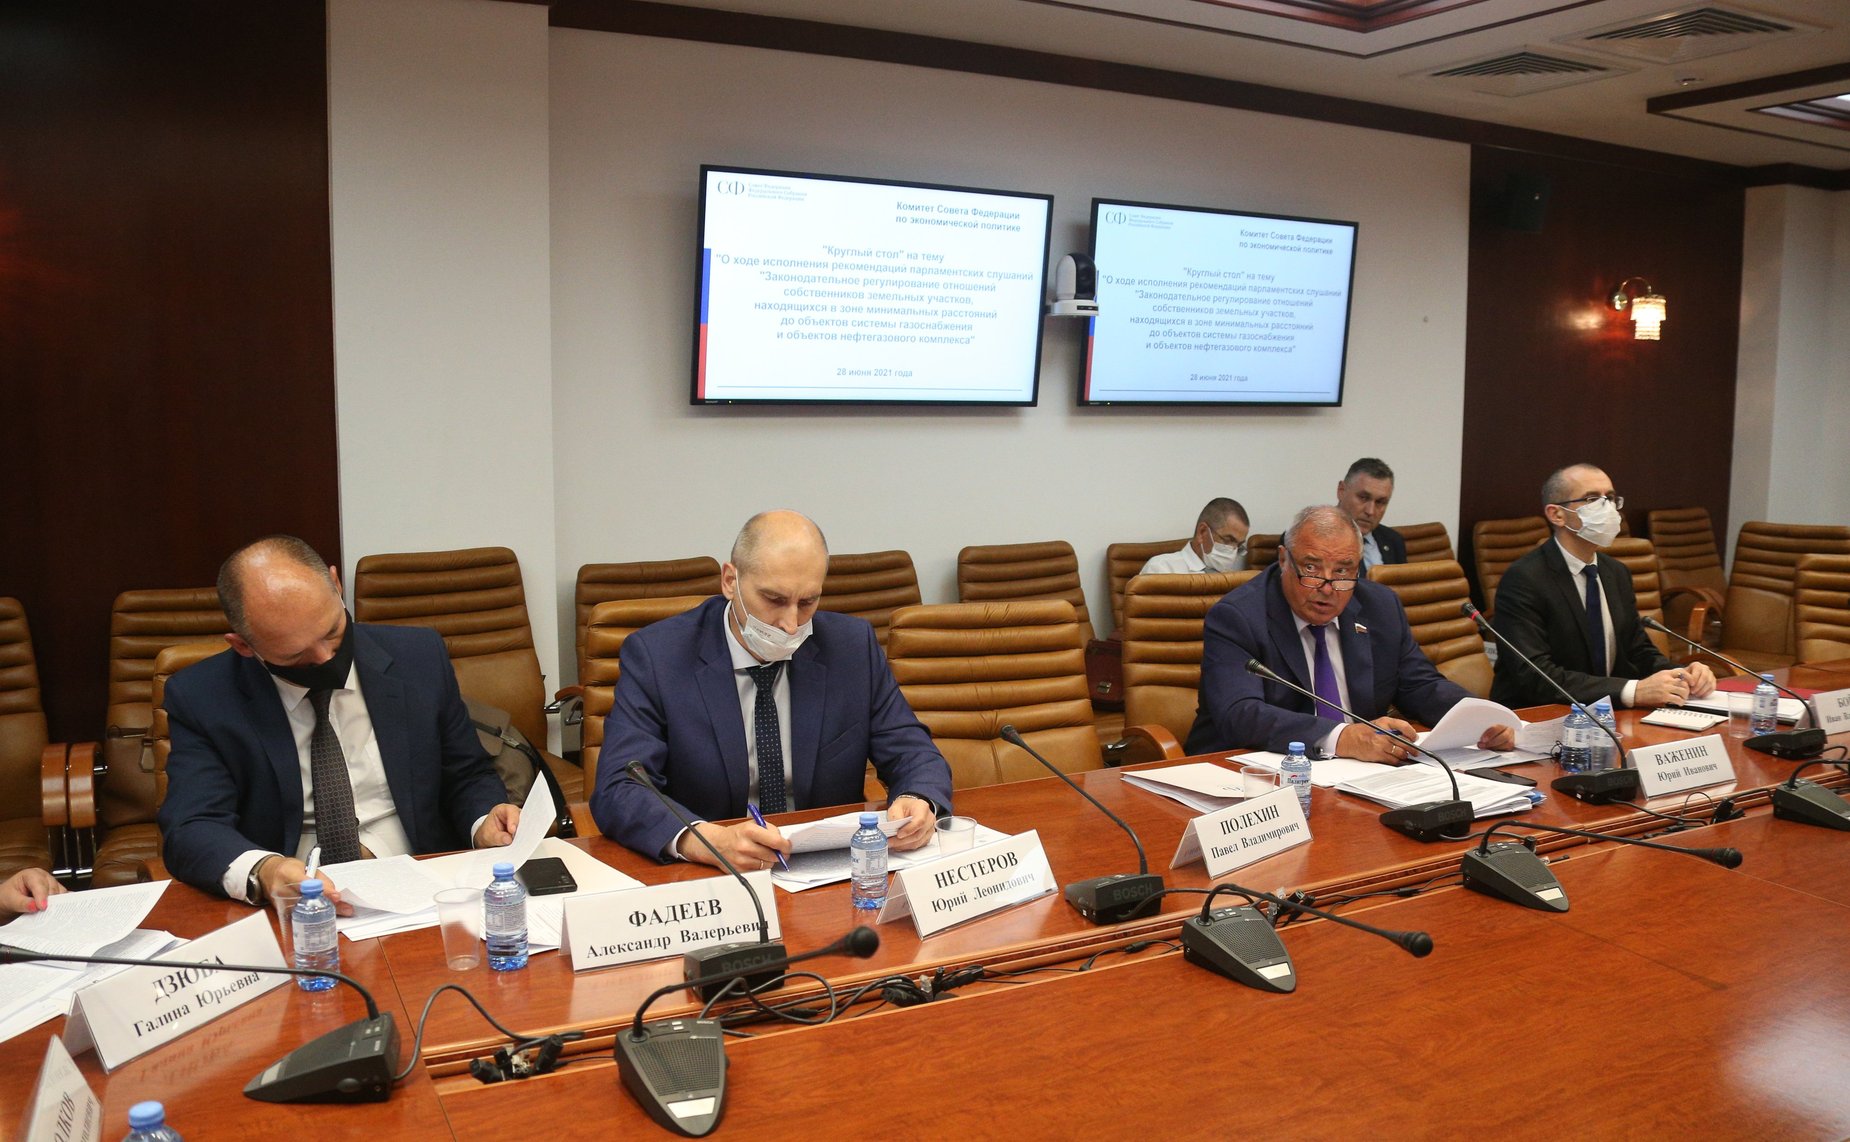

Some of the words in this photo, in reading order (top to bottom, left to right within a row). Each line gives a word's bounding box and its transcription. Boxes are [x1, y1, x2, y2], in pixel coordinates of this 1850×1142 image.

[718, 180, 745, 196] СФ
[896, 201, 934, 212] Комитет
[937, 204, 969, 216] Совета
[972, 208, 1020, 220] Федерации
[896, 216, 908, 224] по
[910, 217, 979, 228] экономической
[980, 222, 1021, 232] политике
[1240, 229, 1269, 239] Комитет
[1270, 232, 1294, 240] Совета
[1296, 234, 1333, 244] Федерации
[822, 244, 873, 258] "Круглый
[875, 250, 904, 259] стол"
[906, 252, 918, 260] на
[922, 252, 944, 264] тему
[1250, 242, 1301, 252] экономической
[1302, 246, 1334, 255] политике
[716, 254, 730, 264] "О
[733, 256, 760, 267] ходе
[763, 258, 828, 269] исполнения
[832, 262, 907, 274] рекомендаций
[910, 266, 984, 278] парламентских
[987, 270, 1034, 282] слушаний
[1183, 266, 1221, 278] "Круглый
[1222, 270, 1245, 279] стол"
[1258, 274, 1275, 283] тему
[760, 271, 860, 286] "Законодательное
[863, 278, 940, 290] регулирование
[942, 282, 996, 292] отношений
[1115, 277, 1136, 286] ходе
[1138, 278, 1188, 288] исполнения
[1189, 281, 1246, 291] рекомендаций
[1248, 286, 1304, 295] парламентских
[784, 287, 865, 300] собственников
[867, 291, 924, 302] земельных
[928, 294, 974, 305] участков,
[1135, 289, 1210, 302] "Законодательное
[1212, 296, 1271, 306] регулирование
[1272, 299, 1314, 307] отношений
[754, 302, 828, 313] находящихся
[830, 305, 837, 313] в
[840, 306, 864, 314] зоне
[866, 306, 938, 316] минимальных
[942, 308, 998, 319] расстояний
[1152, 304, 1214, 314] собственников
[1215, 307, 1258, 316] земельных
[780, 317, 795, 326] до
[798, 316, 848, 328] объектов
[851, 320, 897, 329] системы
[900, 320, 973, 331] газоснабжения
[1130, 316, 1186, 326] находящихся
[1214, 320, 1268, 329] минимальных
[1271, 322, 1314, 331] расстояний
[776, 332, 784, 340] и
[786, 330, 838, 341] объектов
[840, 332, 916, 343] нефтегазового
[918, 335, 976, 345] комплекса"
[1149, 330, 1160, 338] до
[1162, 328, 1201, 339] объектов
[1202, 332, 1237, 340] системы
[1238, 332, 1295, 342] газоснабжения
[1153, 340, 1192, 350] объектов
[1194, 342, 1252, 352] нефтегазового
[836, 368, 847, 376] 28
[848, 369, 872, 377] июня
[874, 368, 892, 377] 2021
[894, 370, 912, 378] года
[1654, 745, 1709, 766] ВАЖЕНИН
[1657, 769, 1682, 782] Юрий
[1683, 763, 1718, 776] Иванович
[1220, 804, 1280, 835] ПОЛЕХИН
[1211, 843, 1239, 859] Павел
[1240, 822, 1300, 850] Владимирович
[934, 851, 1018, 890] НЕСТЕРОВ
[931, 890, 968, 913] Юрий
[973, 872, 1036, 901] Леонидович
[1113, 880, 1152, 901] BOSCH
[628, 898, 723, 928] ФАДЕЕВ
[586, 934, 672, 958] Александр
[721, 953, 773, 974] BOSCH
[133, 1004, 191, 1038] Галина
[195, 971, 260, 1009] Юрьевна
